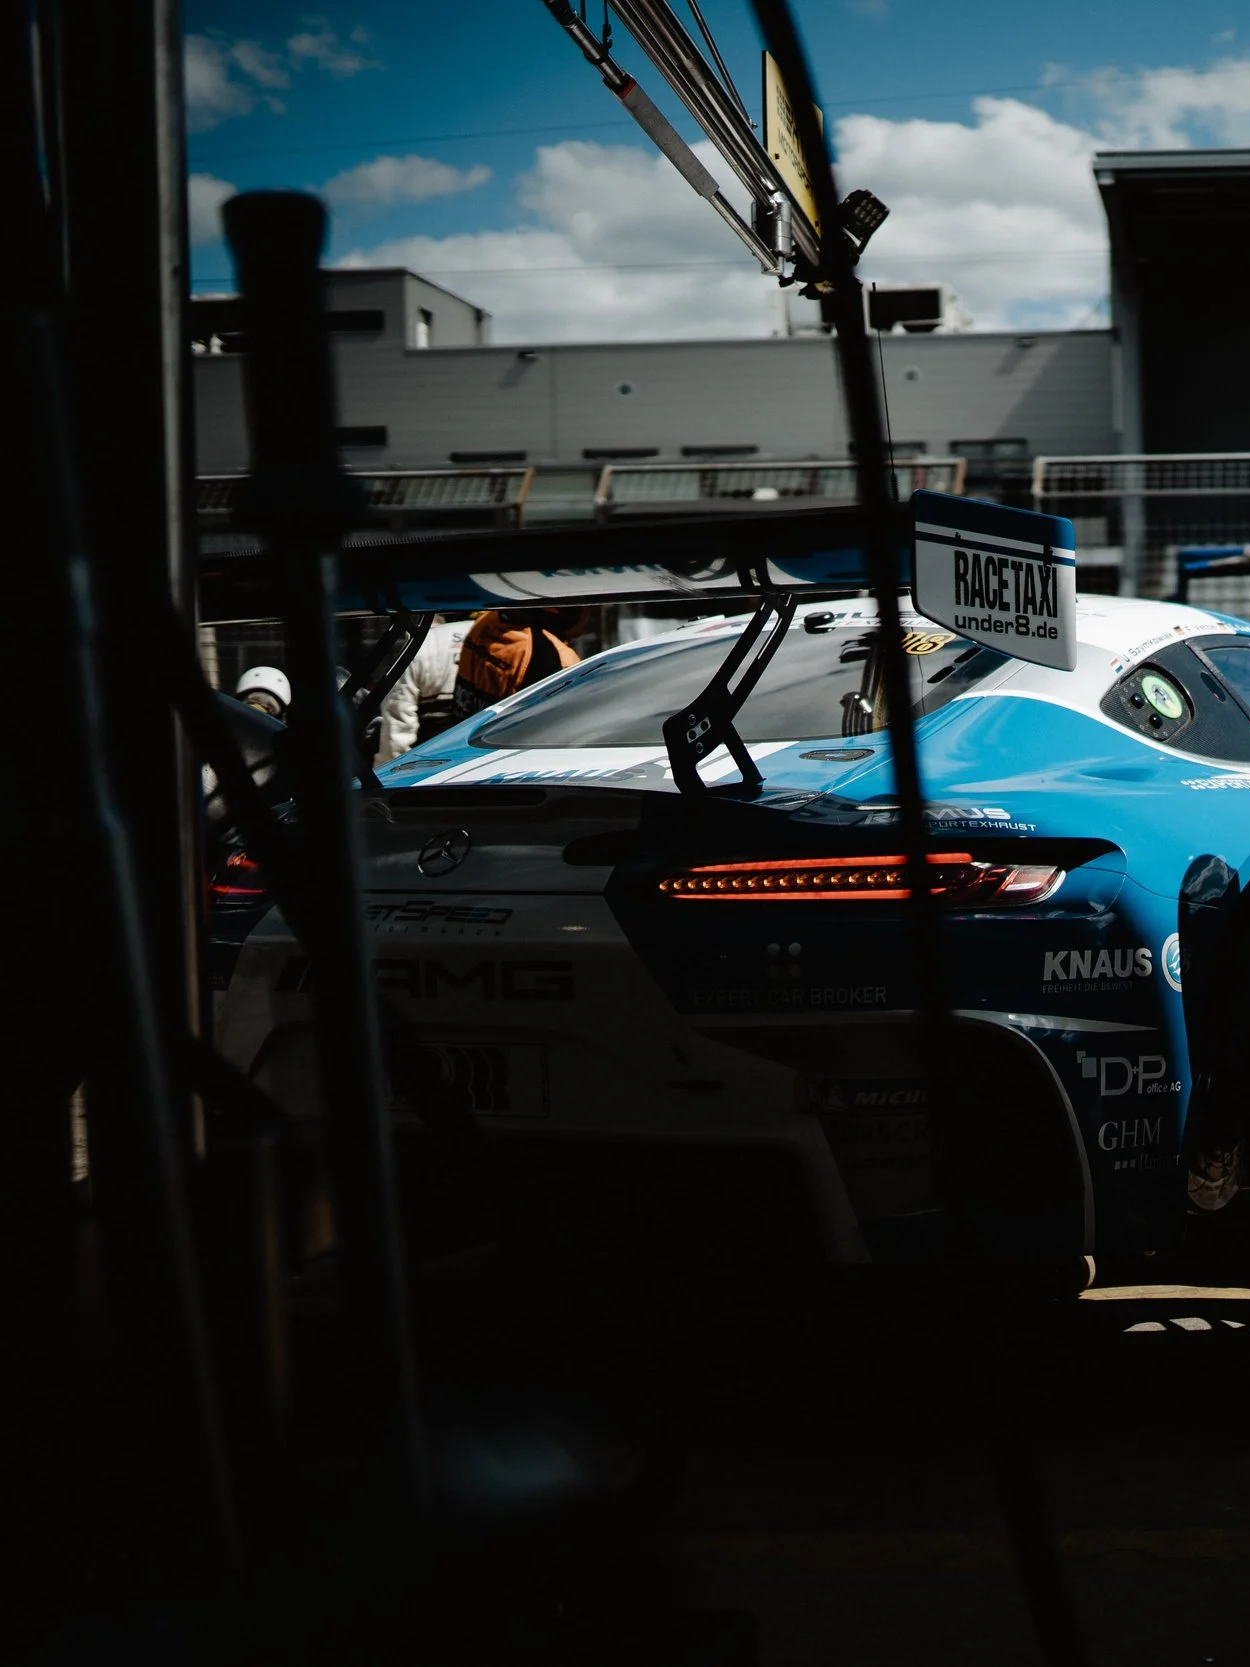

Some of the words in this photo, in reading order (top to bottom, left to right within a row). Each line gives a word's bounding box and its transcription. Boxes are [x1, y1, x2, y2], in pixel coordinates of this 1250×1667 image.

[954, 613, 1058, 639] under8.de
[864, 807, 1011, 824] RMUS
[928, 820, 1037, 832] PORTEXHAUST
[366, 901, 514, 925] ETSPEED
[1043, 948, 1153, 981] KNAUS
[810, 986, 888, 1005] BROKER
[1169, 1080, 1182, 1092] AG
[1098, 1115, 1162, 1151] GHM
